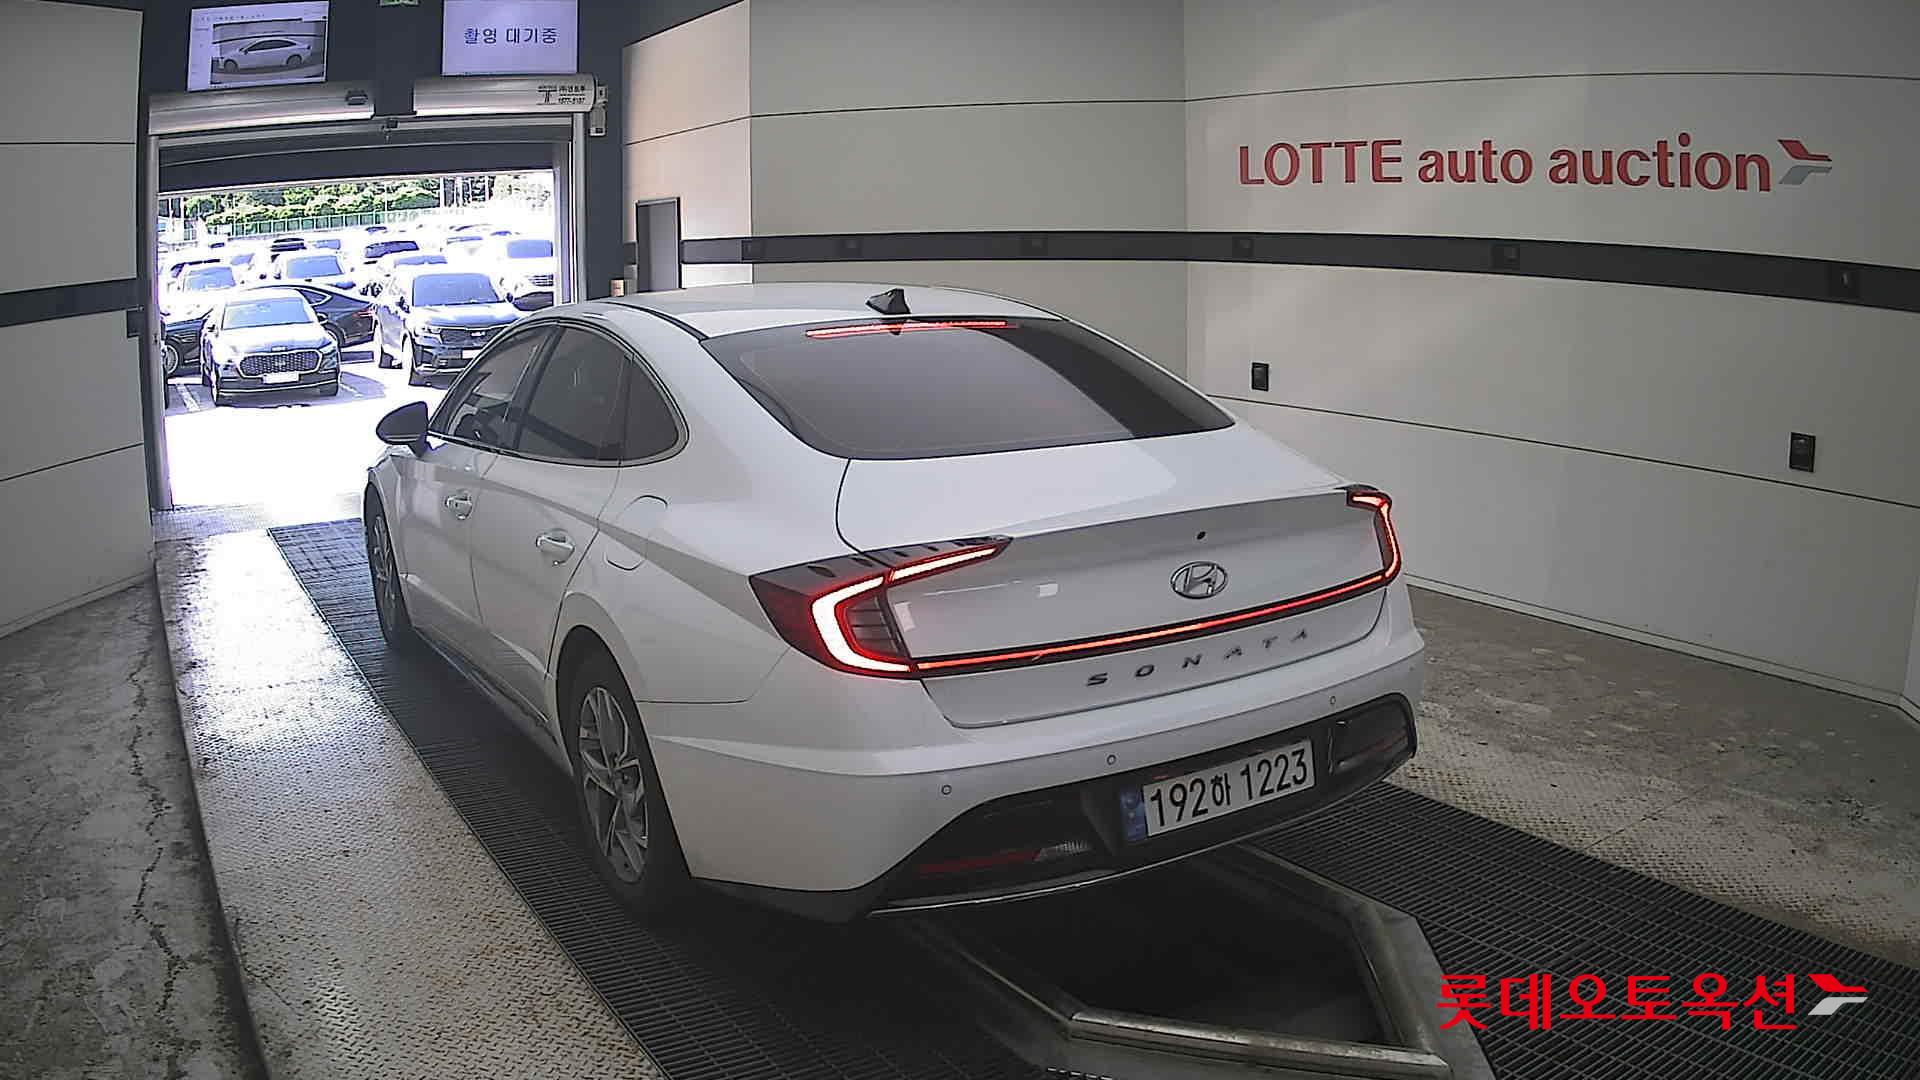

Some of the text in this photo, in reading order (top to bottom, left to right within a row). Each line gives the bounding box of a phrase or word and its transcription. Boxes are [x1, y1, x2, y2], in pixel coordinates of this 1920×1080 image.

[464, 27, 558, 44] 촬영 대기중
[1239, 132, 1772, 192] LOTTE auto auction
[1086, 628, 1308, 687] SONATA
[1151, 749, 1308, 827] 192하 1223
